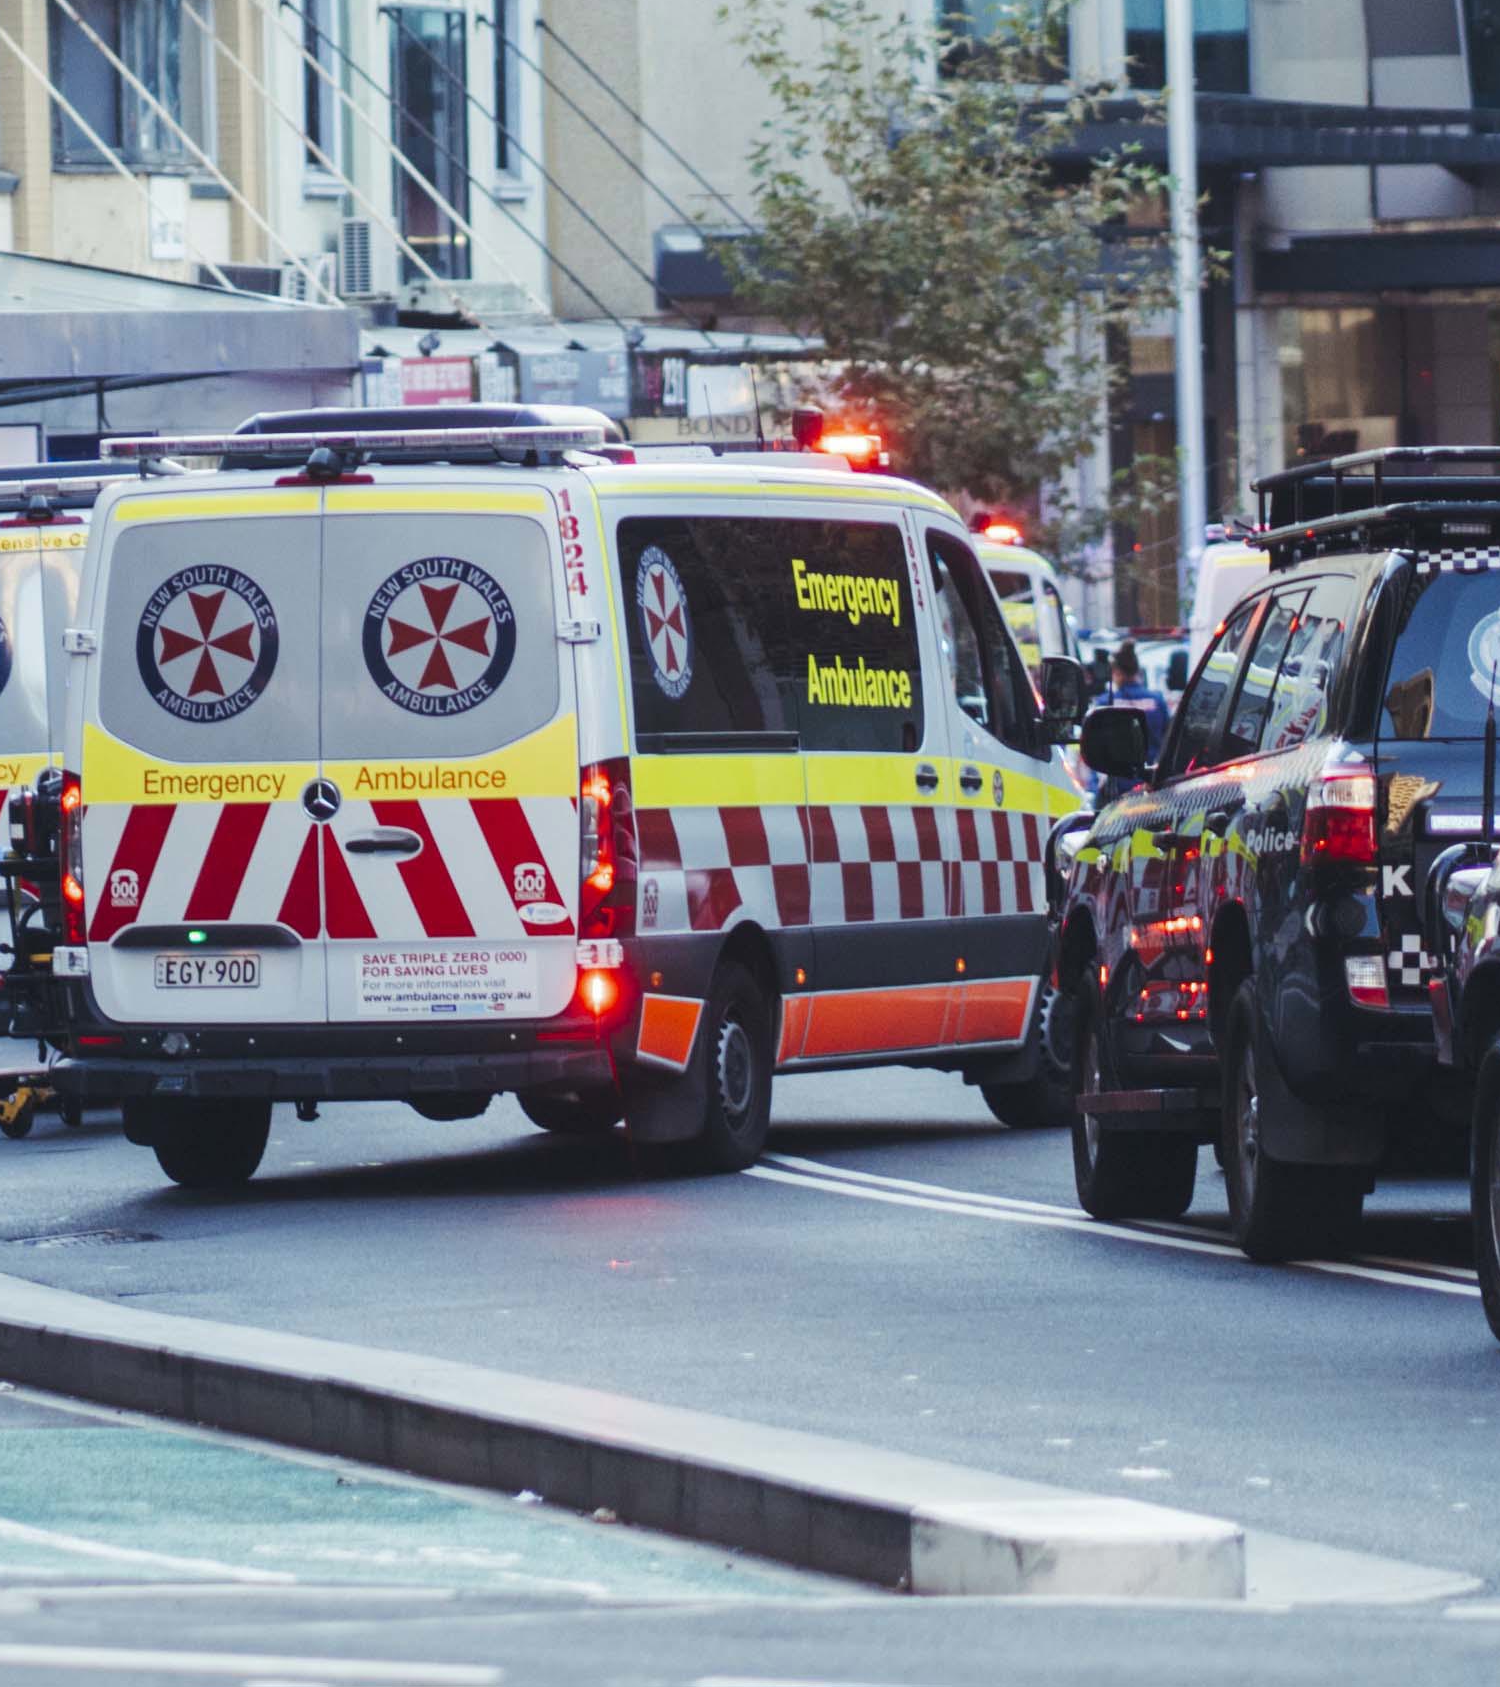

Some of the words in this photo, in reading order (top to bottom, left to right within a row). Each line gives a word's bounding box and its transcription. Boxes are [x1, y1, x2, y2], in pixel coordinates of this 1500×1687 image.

[142, 586, 172, 629] NEW
[171, 566, 230, 592] SOUTH
[231, 573, 275, 630] WALES
[369, 577, 401, 620] NEW
[401, 559, 464, 584] SOUTH
[466, 566, 513, 624] WALES
[791, 558, 900, 628] Emergency
[382, 678, 494, 714] AMBULANCE
[807, 653, 913, 709] Ambulance
[155, 684, 258, 721] AMBULANCE
[143, 768, 286, 801] Emergency
[354, 765, 507, 792] Ambulance
[1246, 827, 1294, 855] Police
[1382, 864, 1414, 899] K
[362, 954, 397, 965] SAVE
[401, 952, 448, 964] TRIPLE
[452, 951, 491, 963] ZERO
[362, 965, 390, 977] FOR
[393, 965, 445, 977] SAVING
[449, 964, 489, 976] LIVES
[416, 978, 480, 989] information
